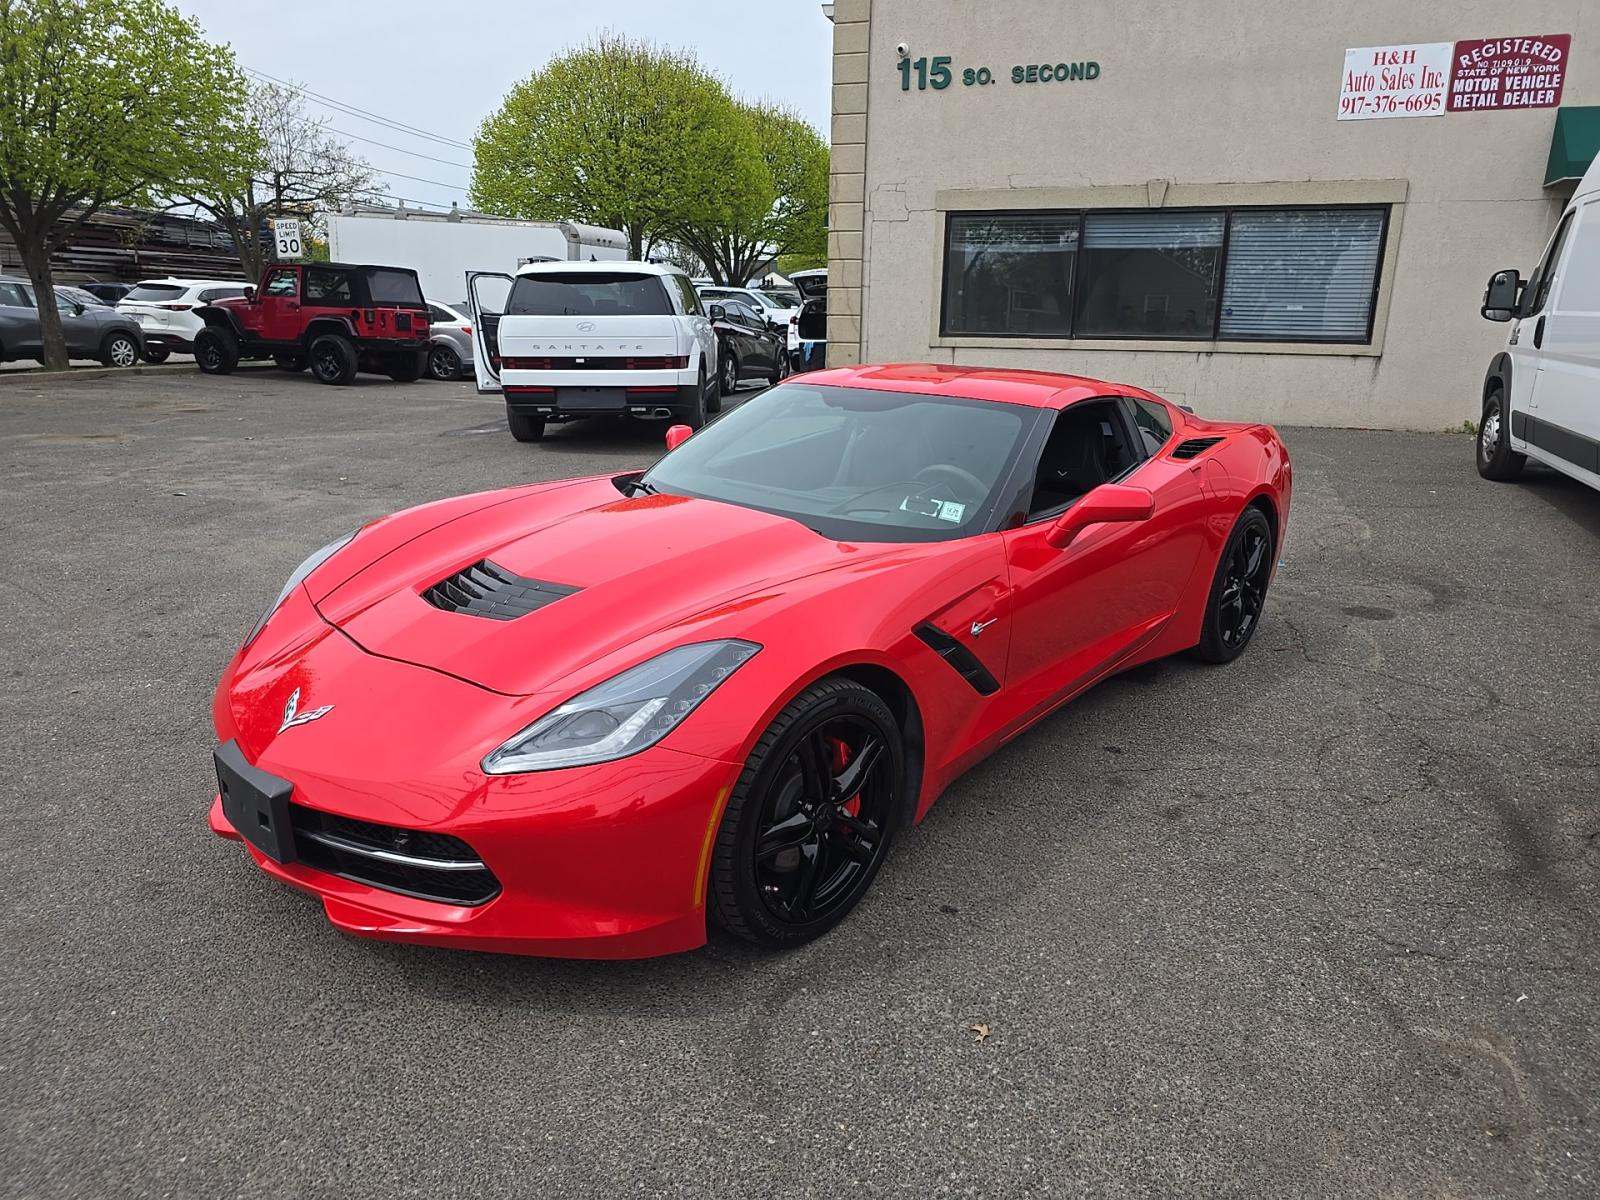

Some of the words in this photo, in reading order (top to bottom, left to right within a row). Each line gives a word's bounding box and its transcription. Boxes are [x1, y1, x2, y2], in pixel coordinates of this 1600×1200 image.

[1372, 50, 1416, 66] H&H
[1459, 39, 1562, 68] REGISTERED
[897, 56, 952, 91] 115
[962, 67, 996, 86] SO.
[1011, 61, 1101, 84] SECOND
[1343, 69, 1375, 92] Auto
[1380, 67, 1415, 91] Sales
[1420, 65, 1445, 89] Inc.
[1457, 68, 1487, 77] STATE
[1490, 67, 1504, 75] OF
[1506, 66, 1529, 75] NEW
[1533, 64, 1560, 73] YORK
[1453, 77, 1500, 93] MOTOR
[1505, 73, 1562, 90] VEHICLE
[1341, 93, 1442, 115] 917-376-6695
[1453, 92, 1498, 108] RETAIL
[1502, 90, 1555, 106] DEALER
[276, 222, 297, 230] SPEED
[279, 230, 296, 238] LIMIT
[279, 239, 300, 254] 30
